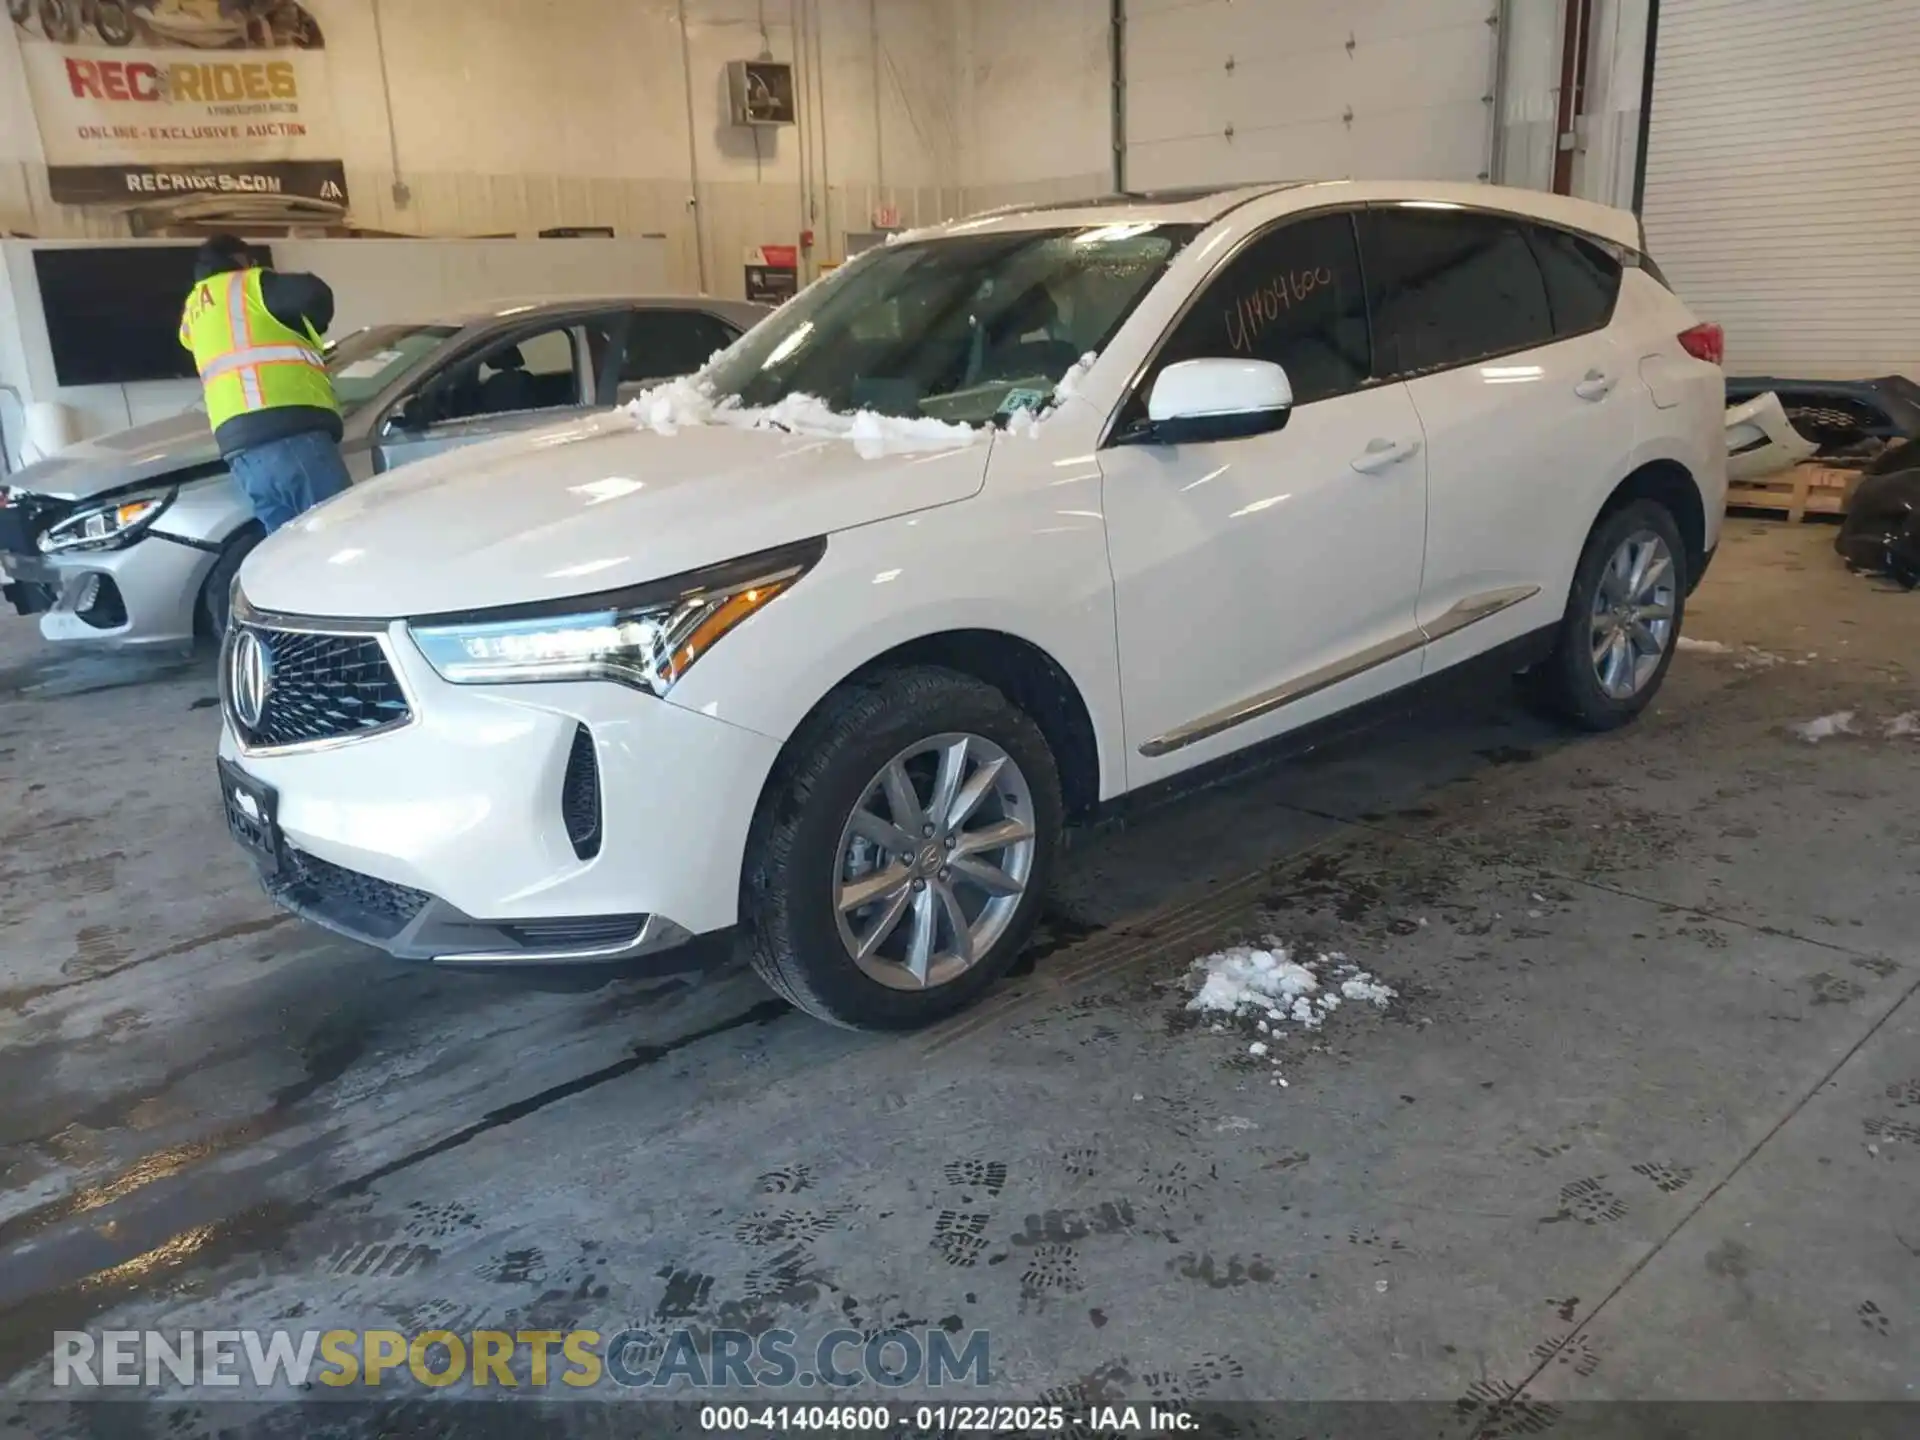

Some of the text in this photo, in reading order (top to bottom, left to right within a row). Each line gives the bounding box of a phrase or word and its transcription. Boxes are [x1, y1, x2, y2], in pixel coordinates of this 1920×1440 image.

[64, 57, 297, 101] REC RIDES
[246, 122, 307, 137] AUCTION
